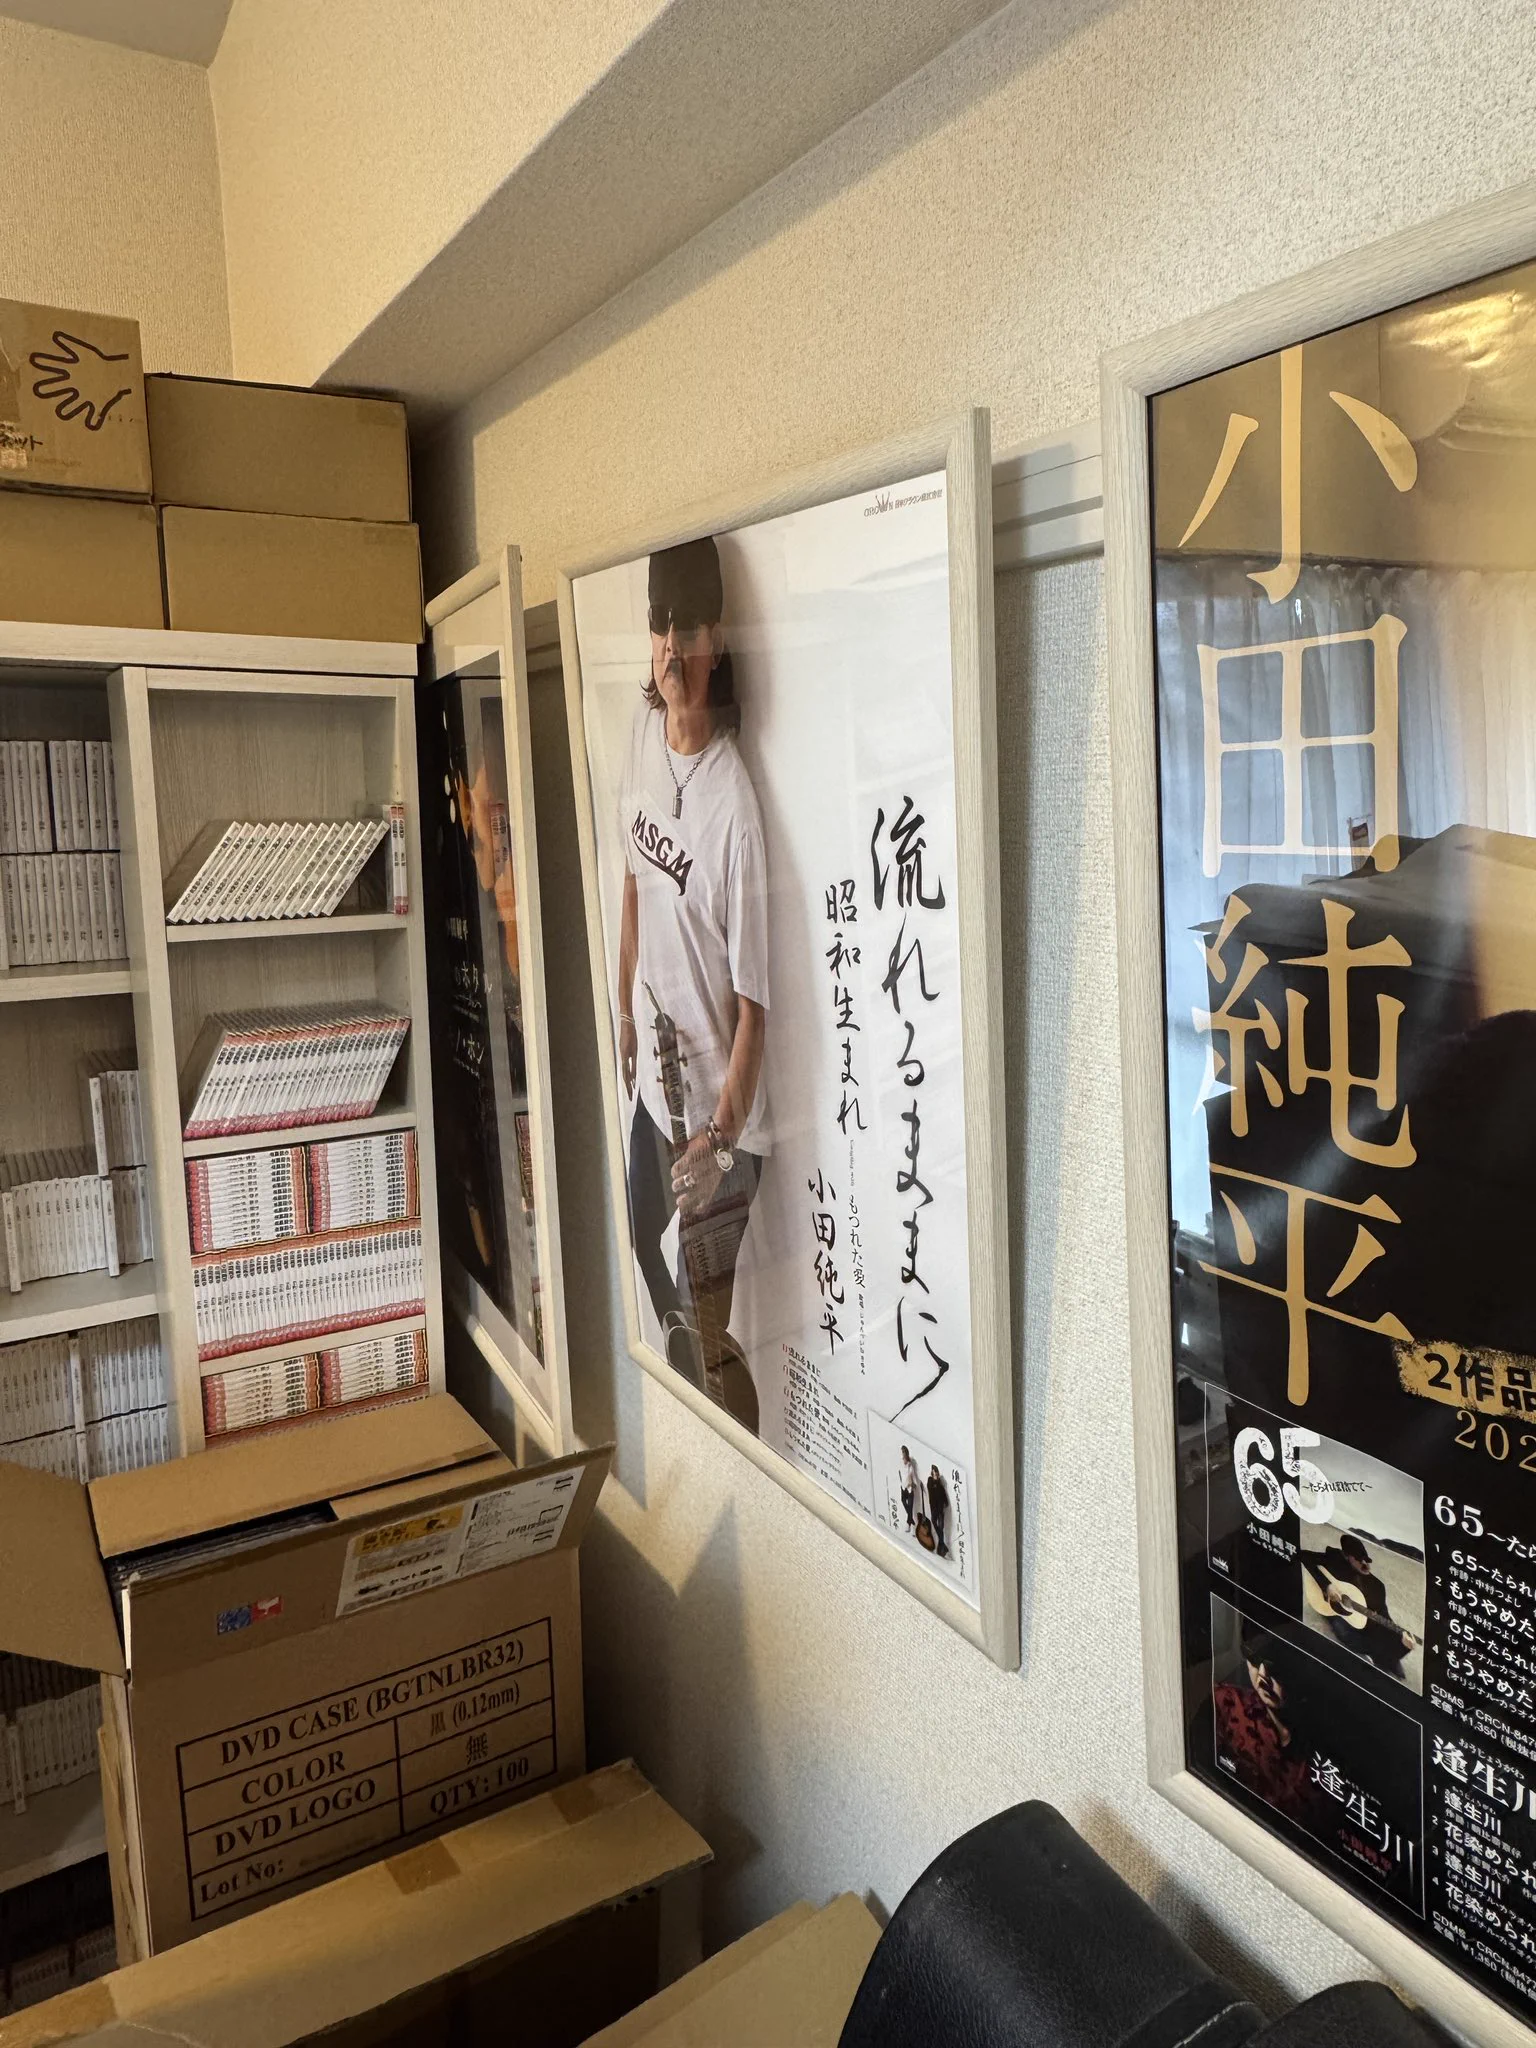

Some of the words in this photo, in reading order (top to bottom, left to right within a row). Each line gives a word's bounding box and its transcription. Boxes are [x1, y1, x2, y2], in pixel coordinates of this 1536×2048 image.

[631, 810, 693, 896] MSGM
[1178, 344, 1418, 1406] 小田純平
[825, 879, 868, 1135] 昭和生まれ
[870, 795, 949, 1422] 流れるままに
[808, 1168, 846, 1356] 小田純平
[1424, 1353, 1536, 1412] 2作品
[1233, 1427, 1335, 1524] 65
[1454, 1410, 1536, 1473] 202
[1451, 1550, 1536, 1601] 65～たられ
[221, 1726, 281, 1766] DVD
[289, 1697, 360, 1740] CASE
[367, 1638, 525, 1718] (BGTNLBR32)
[453, 1681, 521, 1727] (0.12mm)
[242, 1750, 347, 1804] COLOR
[430, 1778, 491, 1815] QTY:
[498, 1756, 530, 1786] 100
[215, 1814, 282, 1856] DVD
[291, 1778, 377, 1825] LOGO
[201, 1876, 239, 1903] Lot
[246, 1857, 285, 1885] No:
